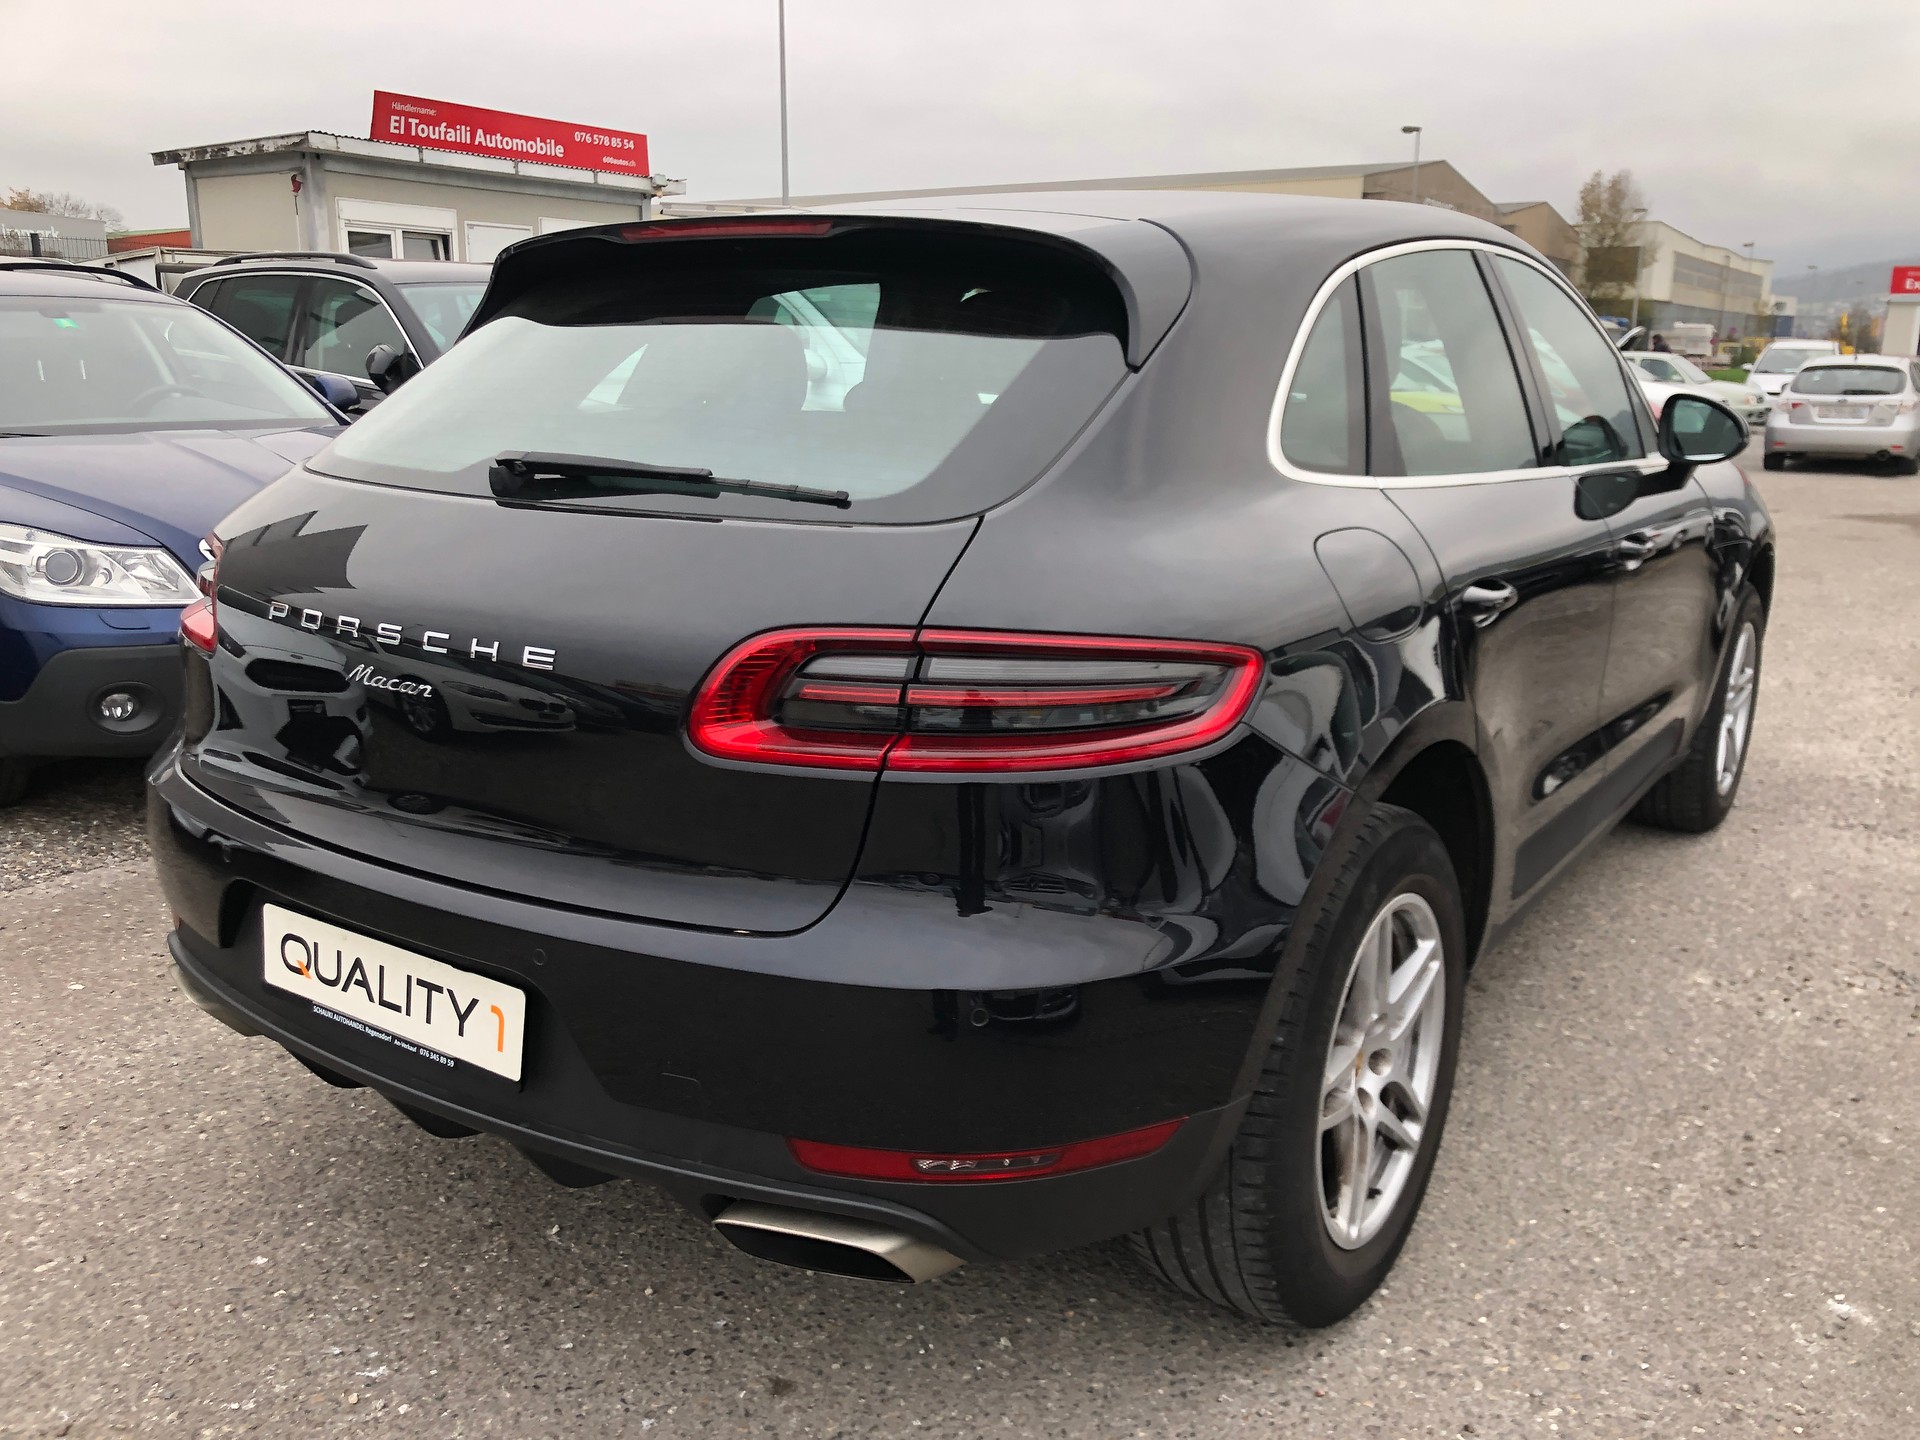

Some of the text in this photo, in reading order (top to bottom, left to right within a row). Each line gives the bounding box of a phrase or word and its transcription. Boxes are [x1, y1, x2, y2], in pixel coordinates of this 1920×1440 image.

[389, 115, 565, 158] El Toufaili Automobile
[574, 131, 635, 151] 076 578 85 54
[268, 601, 556, 671] PORSCHE
[345, 663, 433, 698] Macan
[333, 1013, 365, 1032] AUTOHANDEL
